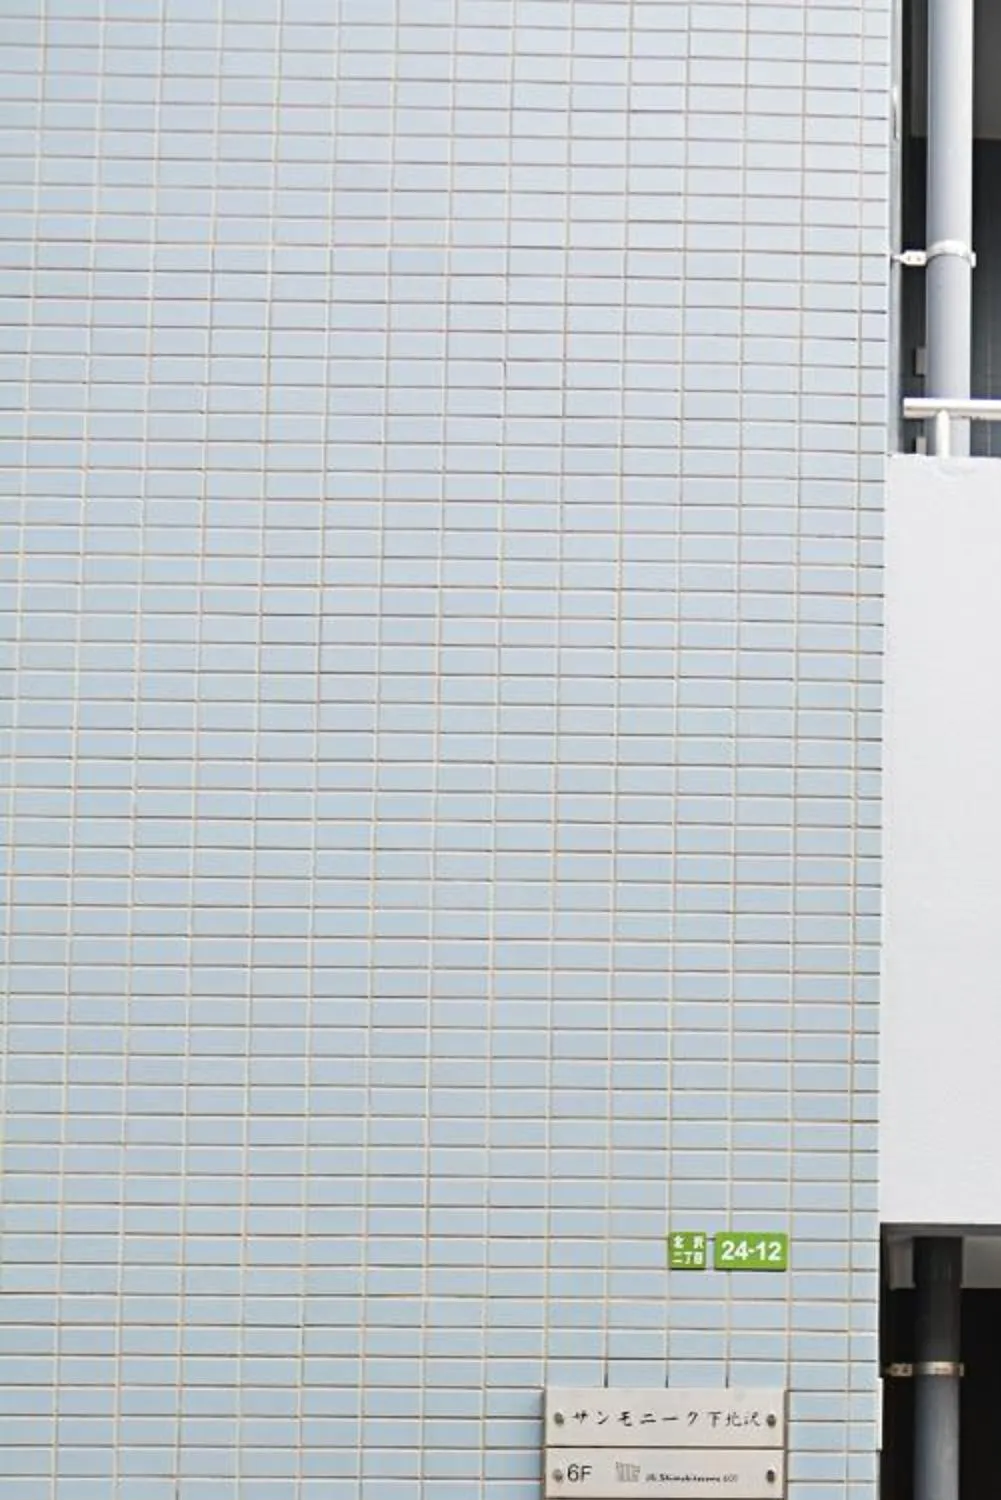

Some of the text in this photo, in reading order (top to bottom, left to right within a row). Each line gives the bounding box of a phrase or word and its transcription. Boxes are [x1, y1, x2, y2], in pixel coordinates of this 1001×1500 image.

[671, 1251, 703, 1265] 二丁目
[721, 1240, 782, 1261] 24-12
[571, 1411, 761, 1428] サンモニーク下北沢
[566, 1463, 592, 1482] 6F
